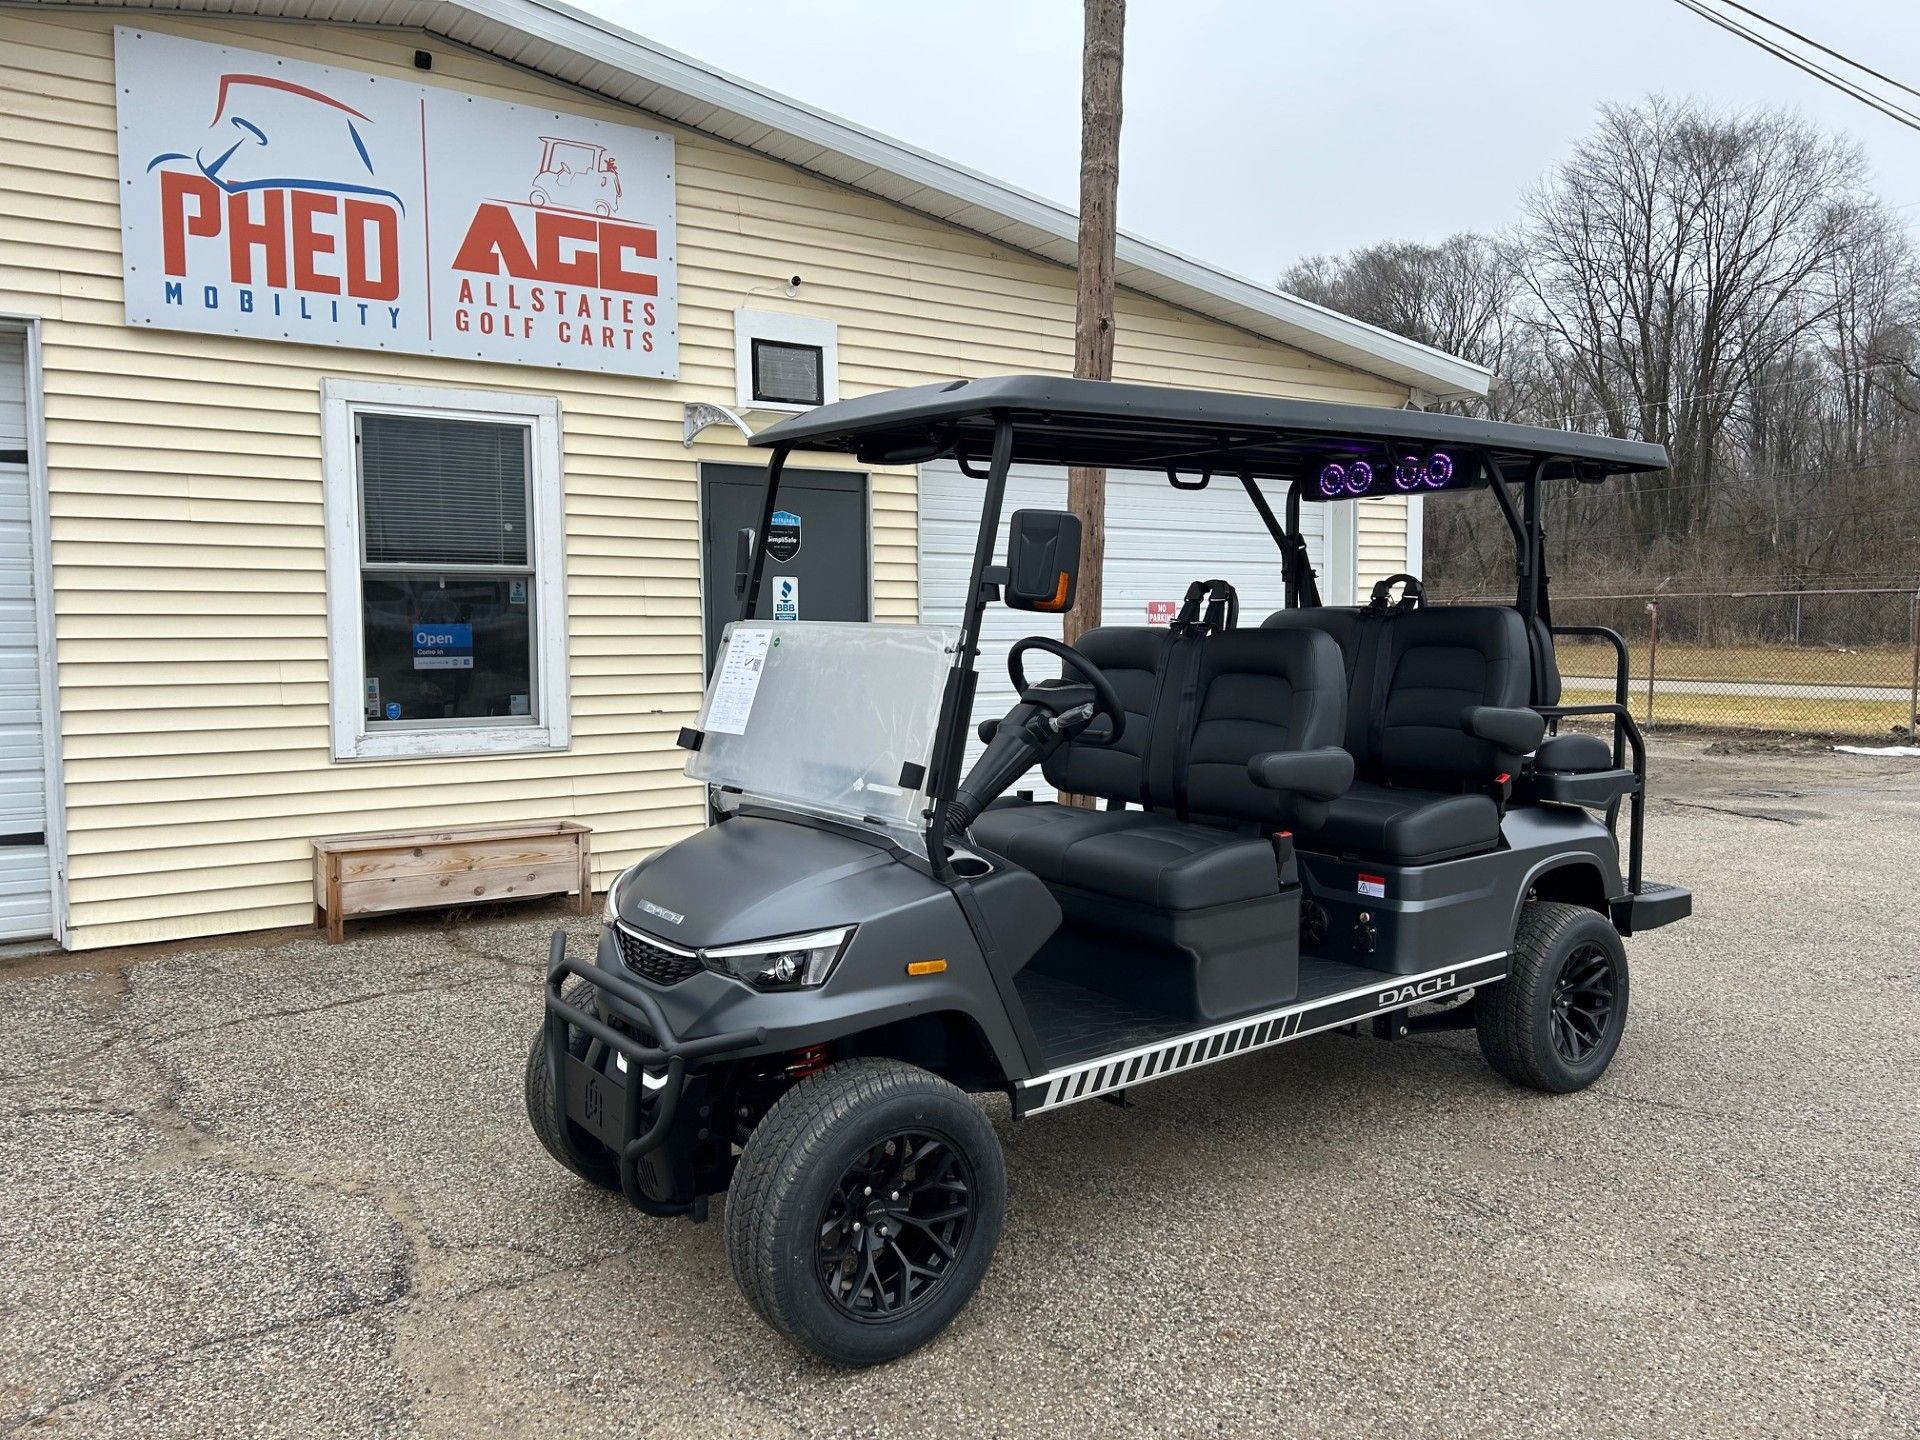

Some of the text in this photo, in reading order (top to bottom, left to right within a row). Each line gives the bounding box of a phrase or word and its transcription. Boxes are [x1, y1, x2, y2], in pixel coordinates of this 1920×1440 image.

[161, 170, 400, 302] PHED
[451, 203, 658, 296] AGC
[165, 281, 400, 329] MOBILITY
[458, 278, 656, 326] ALLSTATES
[455, 309, 653, 352] GOLF CARTS
[767, 535, 797, 544] SimpliSafe
[776, 604, 795, 612] BBB
[1157, 604, 1167, 612] NO
[416, 632, 453, 646] Open
[1379, 974, 1455, 1006] DACH
